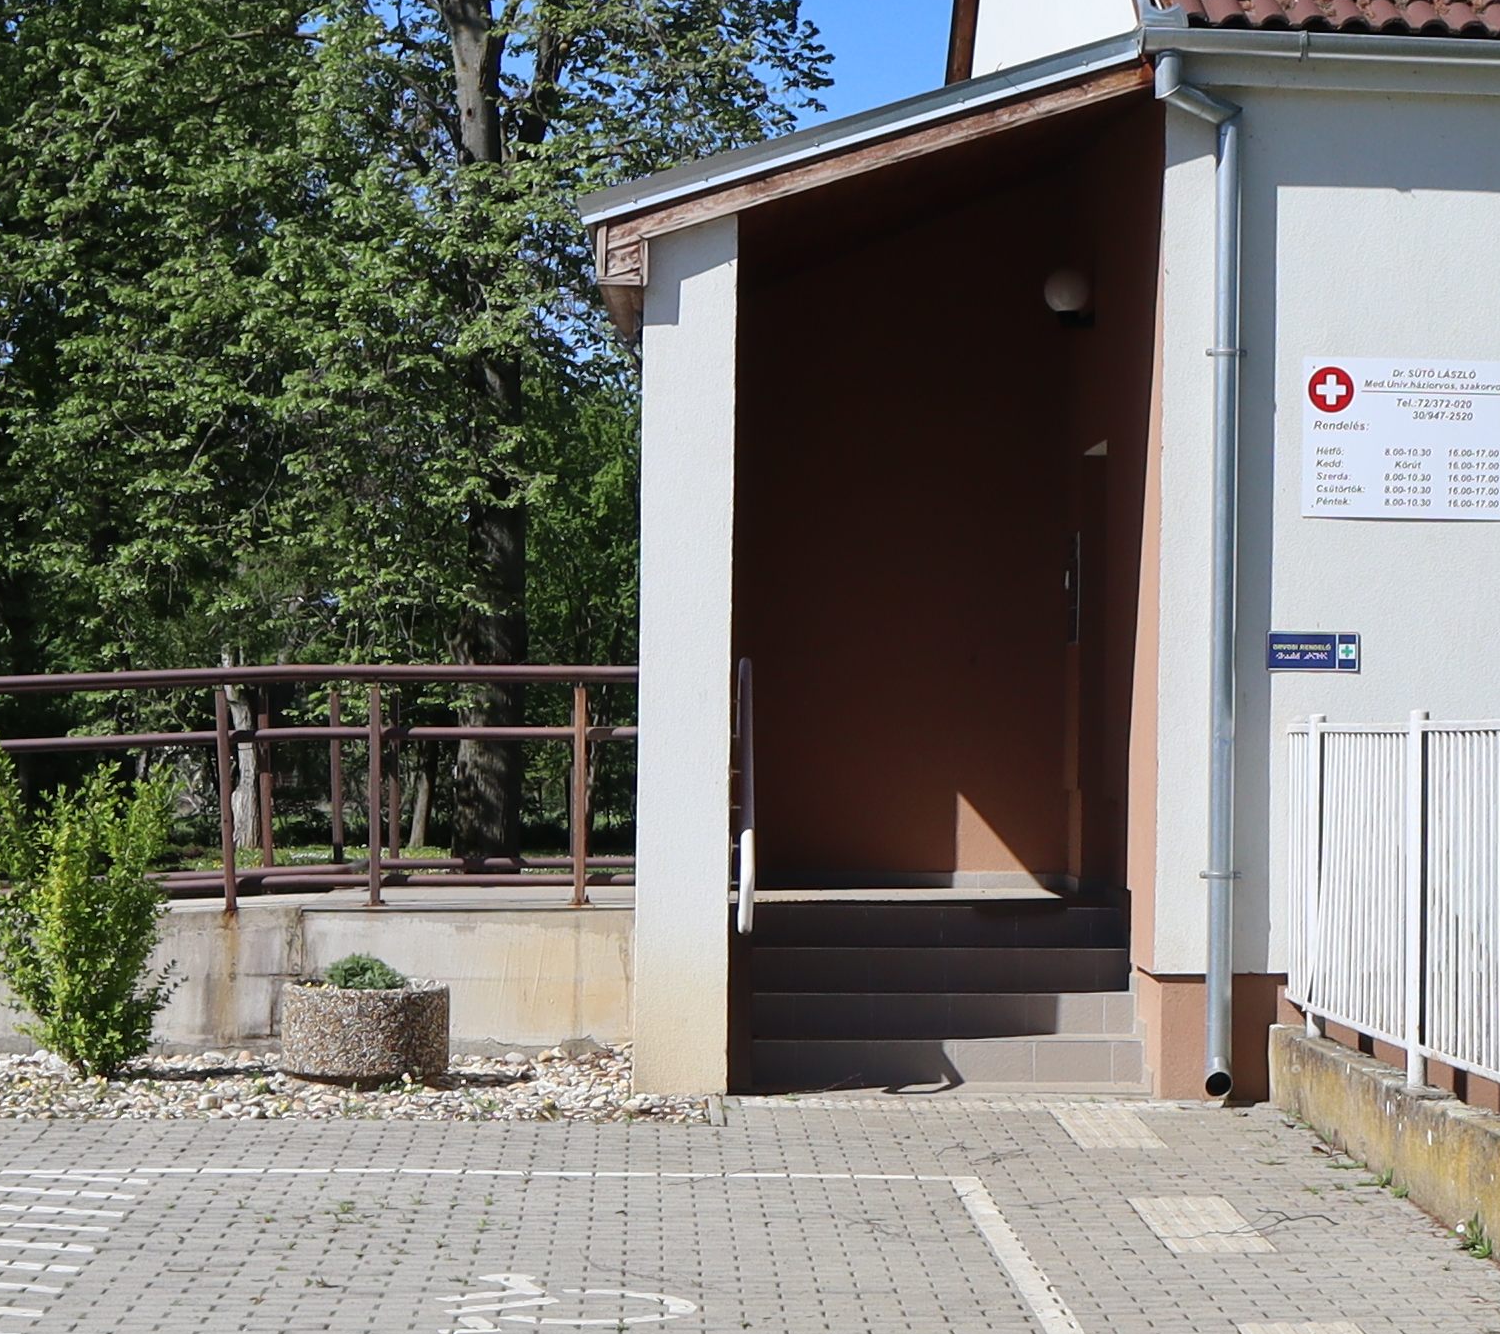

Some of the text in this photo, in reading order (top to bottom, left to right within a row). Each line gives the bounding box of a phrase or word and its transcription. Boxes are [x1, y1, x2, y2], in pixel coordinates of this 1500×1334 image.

[1392, 369, 1406, 378] Dr.
[1437, 368, 1476, 380] LÁSZLÓ
[1412, 411, 1473, 421] 30/947-2520
[1313, 420, 1370, 431] Rendelés:
[1315, 459, 1344, 468] Kedd:
[1316, 472, 1352, 482] Szerda:
